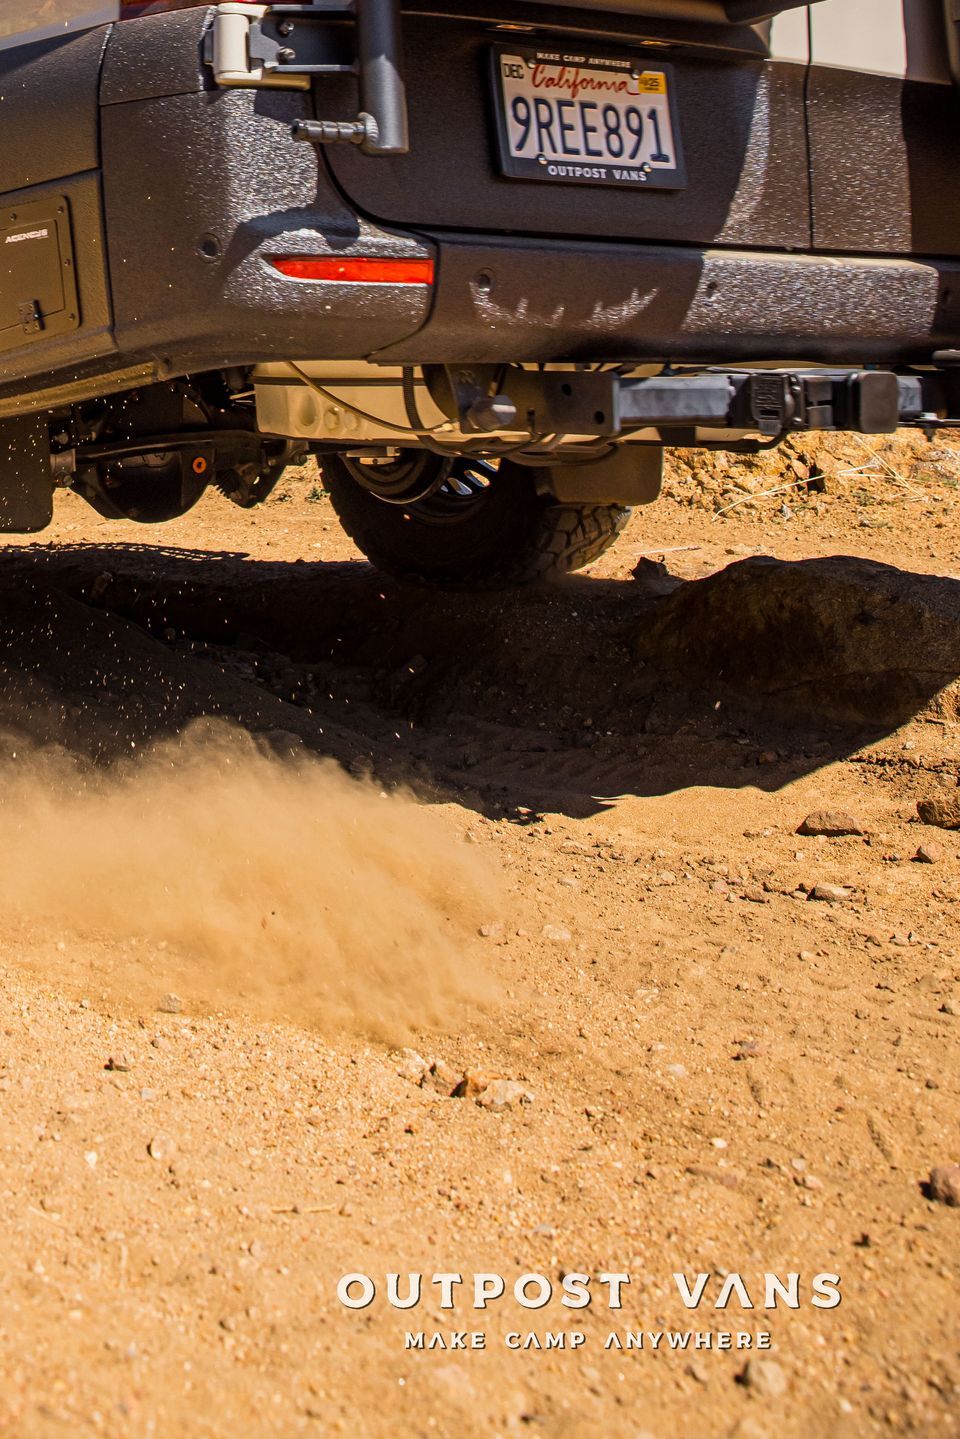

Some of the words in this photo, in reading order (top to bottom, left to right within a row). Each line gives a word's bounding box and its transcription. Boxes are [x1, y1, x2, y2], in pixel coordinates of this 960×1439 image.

[536, 52, 561, 61] MAKE
[563, 55, 586, 63] CAMP
[588, 58, 632, 69] ANYWHERE
[531, 63, 640, 99] California
[511, 96, 670, 163] 9REE891
[547, 165, 607, 179] OUTPOST
[613, 169, 647, 181] VANS
